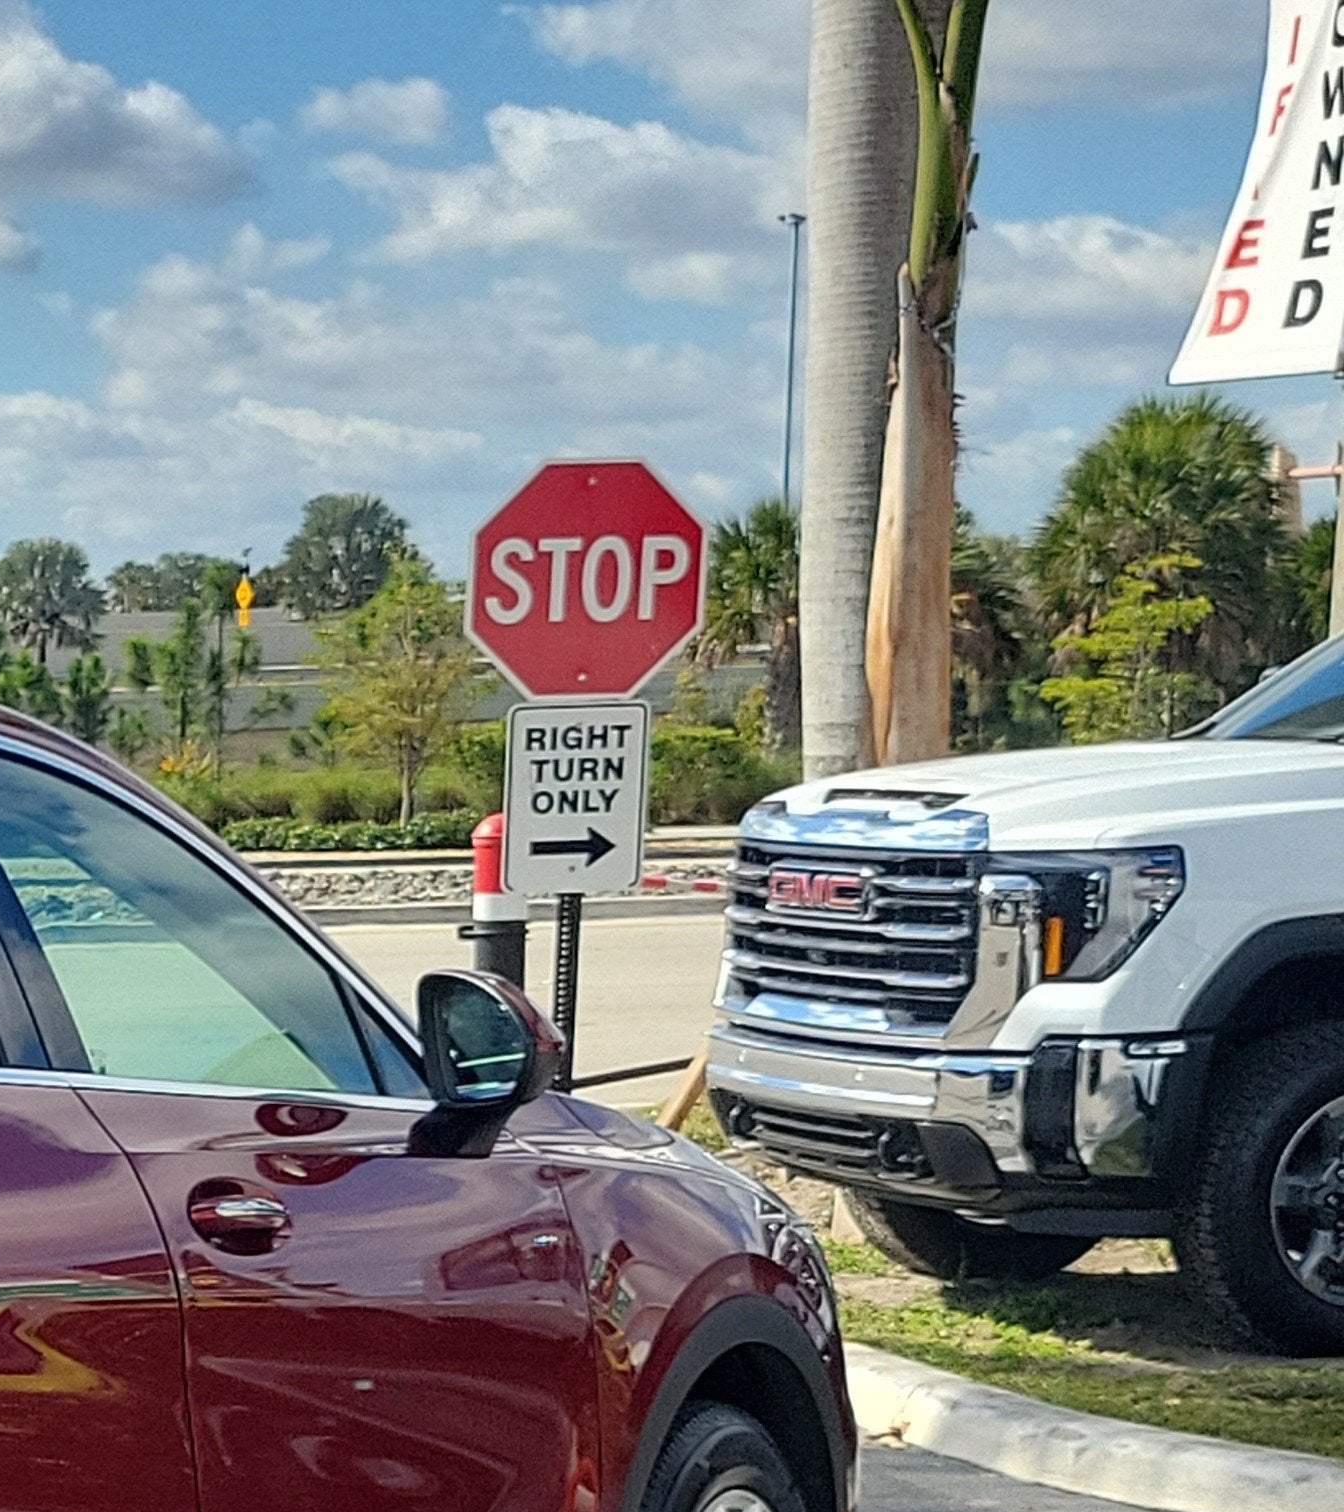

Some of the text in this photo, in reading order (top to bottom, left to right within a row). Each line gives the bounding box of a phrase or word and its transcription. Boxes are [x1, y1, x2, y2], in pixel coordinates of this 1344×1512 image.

[484, 534, 690, 625] STOP
[524, 724, 633, 752] RIGHT
[530, 757, 625, 784] TURN
[530, 789, 620, 815] ONLY
[768, 871, 864, 911] GMC
